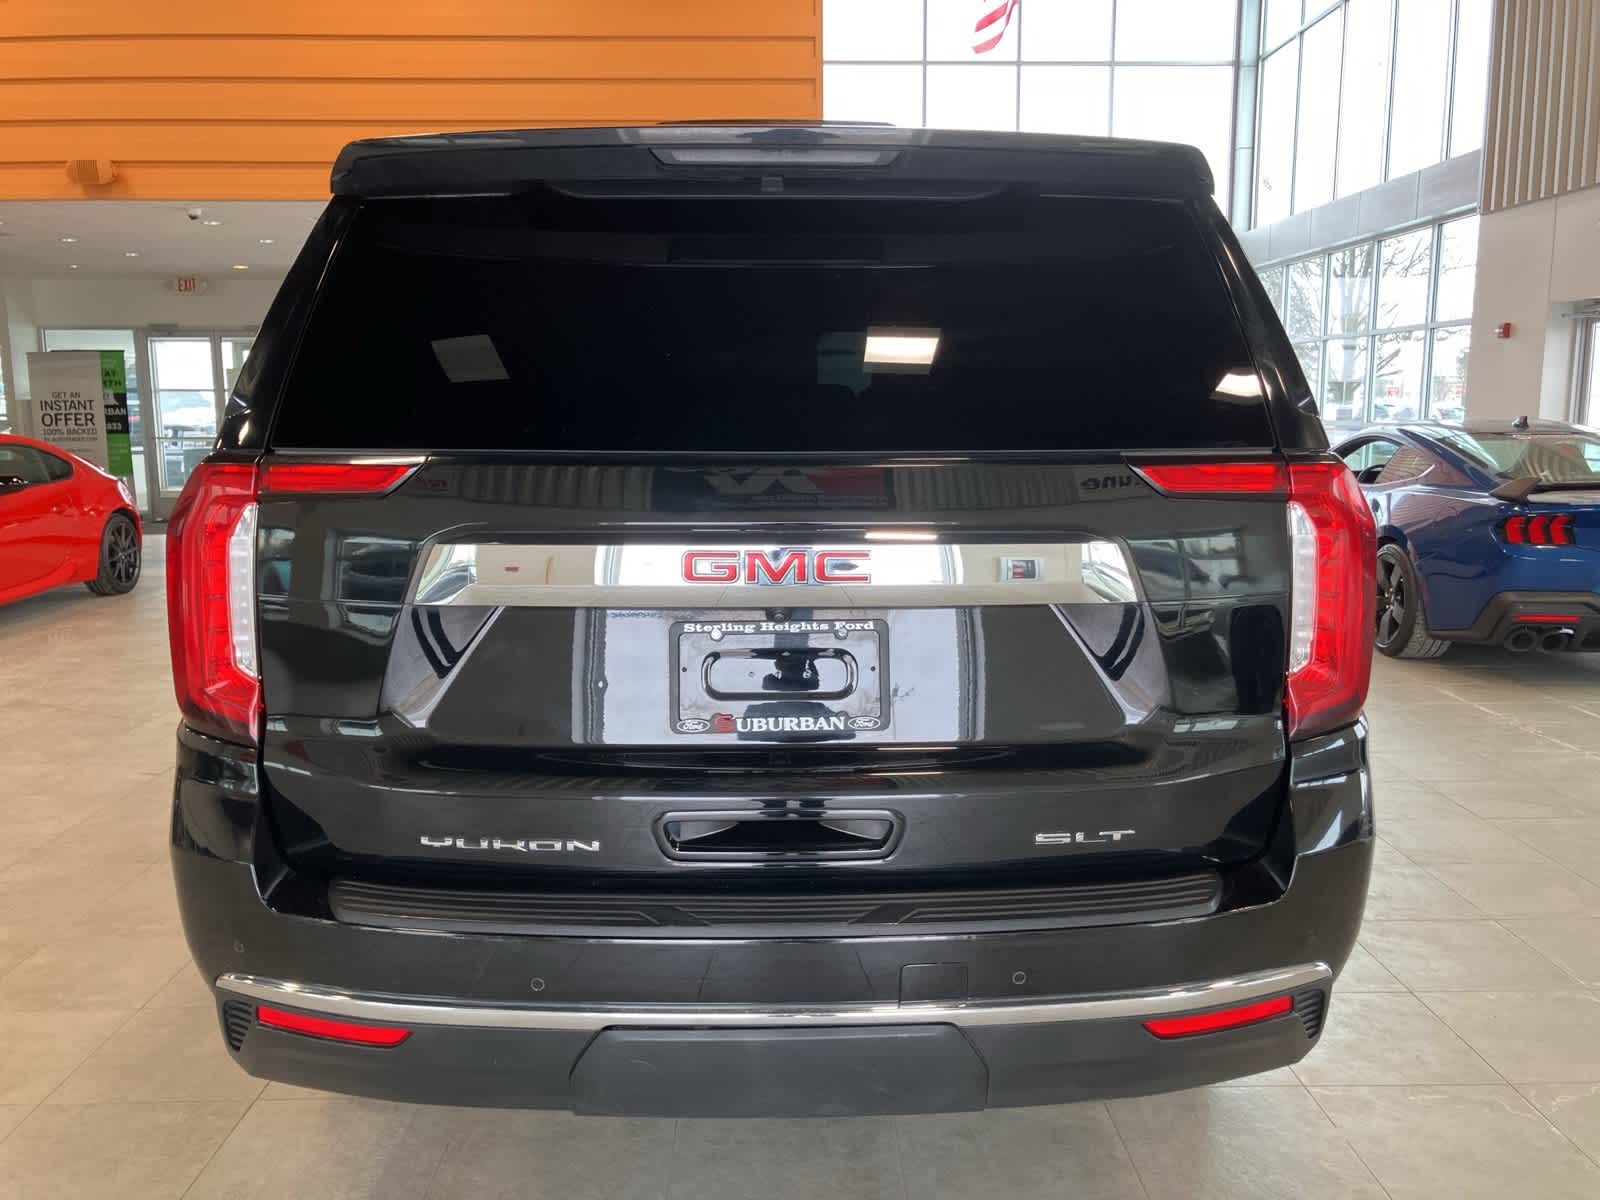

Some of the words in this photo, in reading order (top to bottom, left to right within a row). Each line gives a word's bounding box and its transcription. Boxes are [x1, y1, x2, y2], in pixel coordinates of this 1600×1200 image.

[177, 277, 196, 292] EXIT
[51, 391, 66, 399] GET
[69, 391, 81, 399] AN
[40, 399, 95, 411] INSTANT
[41, 412, 96, 427] OFFER
[43, 428, 65, 436] 100%
[66, 428, 98, 436] BACKED
[681, 550, 871, 584] GMC
[683, 622, 755, 634] Sterling
[759, 621, 829, 633] Heights
[833, 620, 875, 631] Ford
[680, 720, 708, 731] Ford
[710, 713, 846, 732] SUBURBAN
[851, 717, 877, 729] Ford
[420, 835, 600, 852] YUKON
[1035, 829, 1136, 845] SLT
